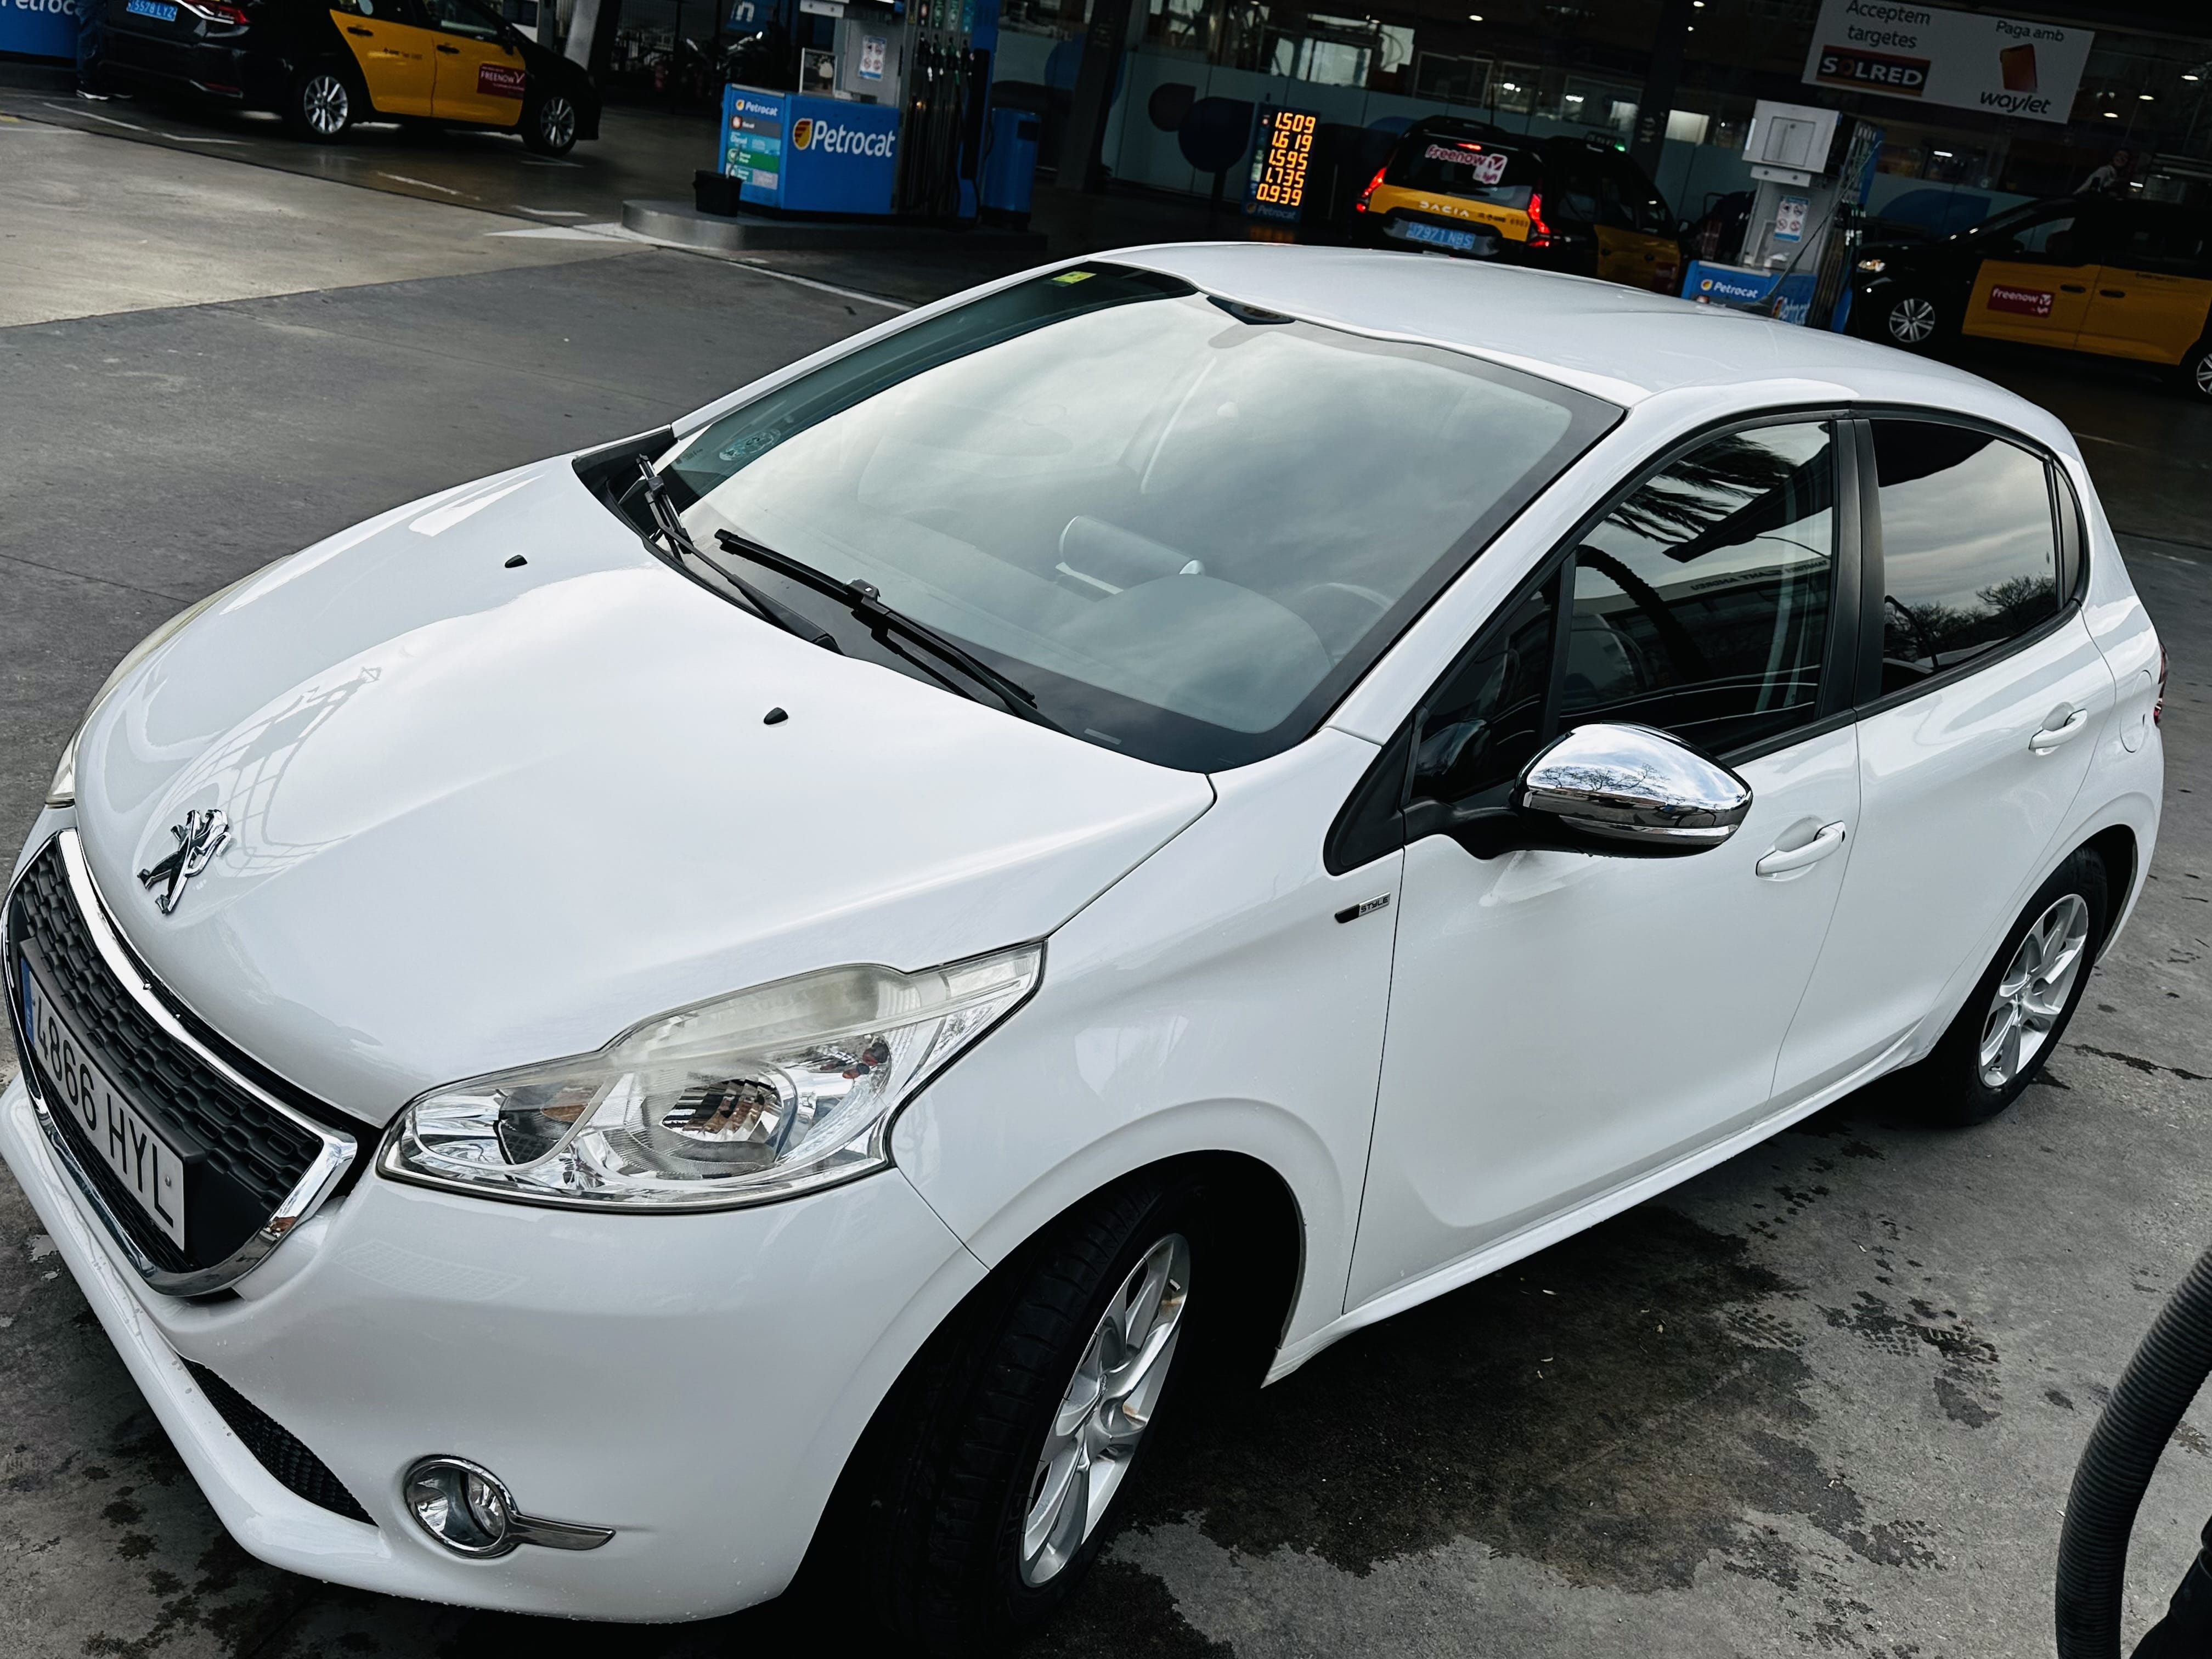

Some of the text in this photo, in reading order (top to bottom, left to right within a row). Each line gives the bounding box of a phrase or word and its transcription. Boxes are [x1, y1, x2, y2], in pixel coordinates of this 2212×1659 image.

[1846, 0, 1932, 26] Acceptem
[1847, 25, 1918, 49] targetes
[1996, 20, 2064, 42] Paga amb
[1821, 57, 1923, 86] SOLRED
[1980, 89, 2051, 115] waylet
[1274, 111, 1317, 134] 1.509
[811, 120, 895, 157] Petrocat
[1268, 149, 1309, 170] 1.595
[1265, 167, 1306, 188] 1.735
[1256, 183, 1302, 206] 0.939
[1419, 200, 1470, 218] DACIA
[1713, 281, 1759, 298] Petrocat
[1360, 896, 1389, 912] STYLE
[36, 995, 174, 1228] 4866 HYL
